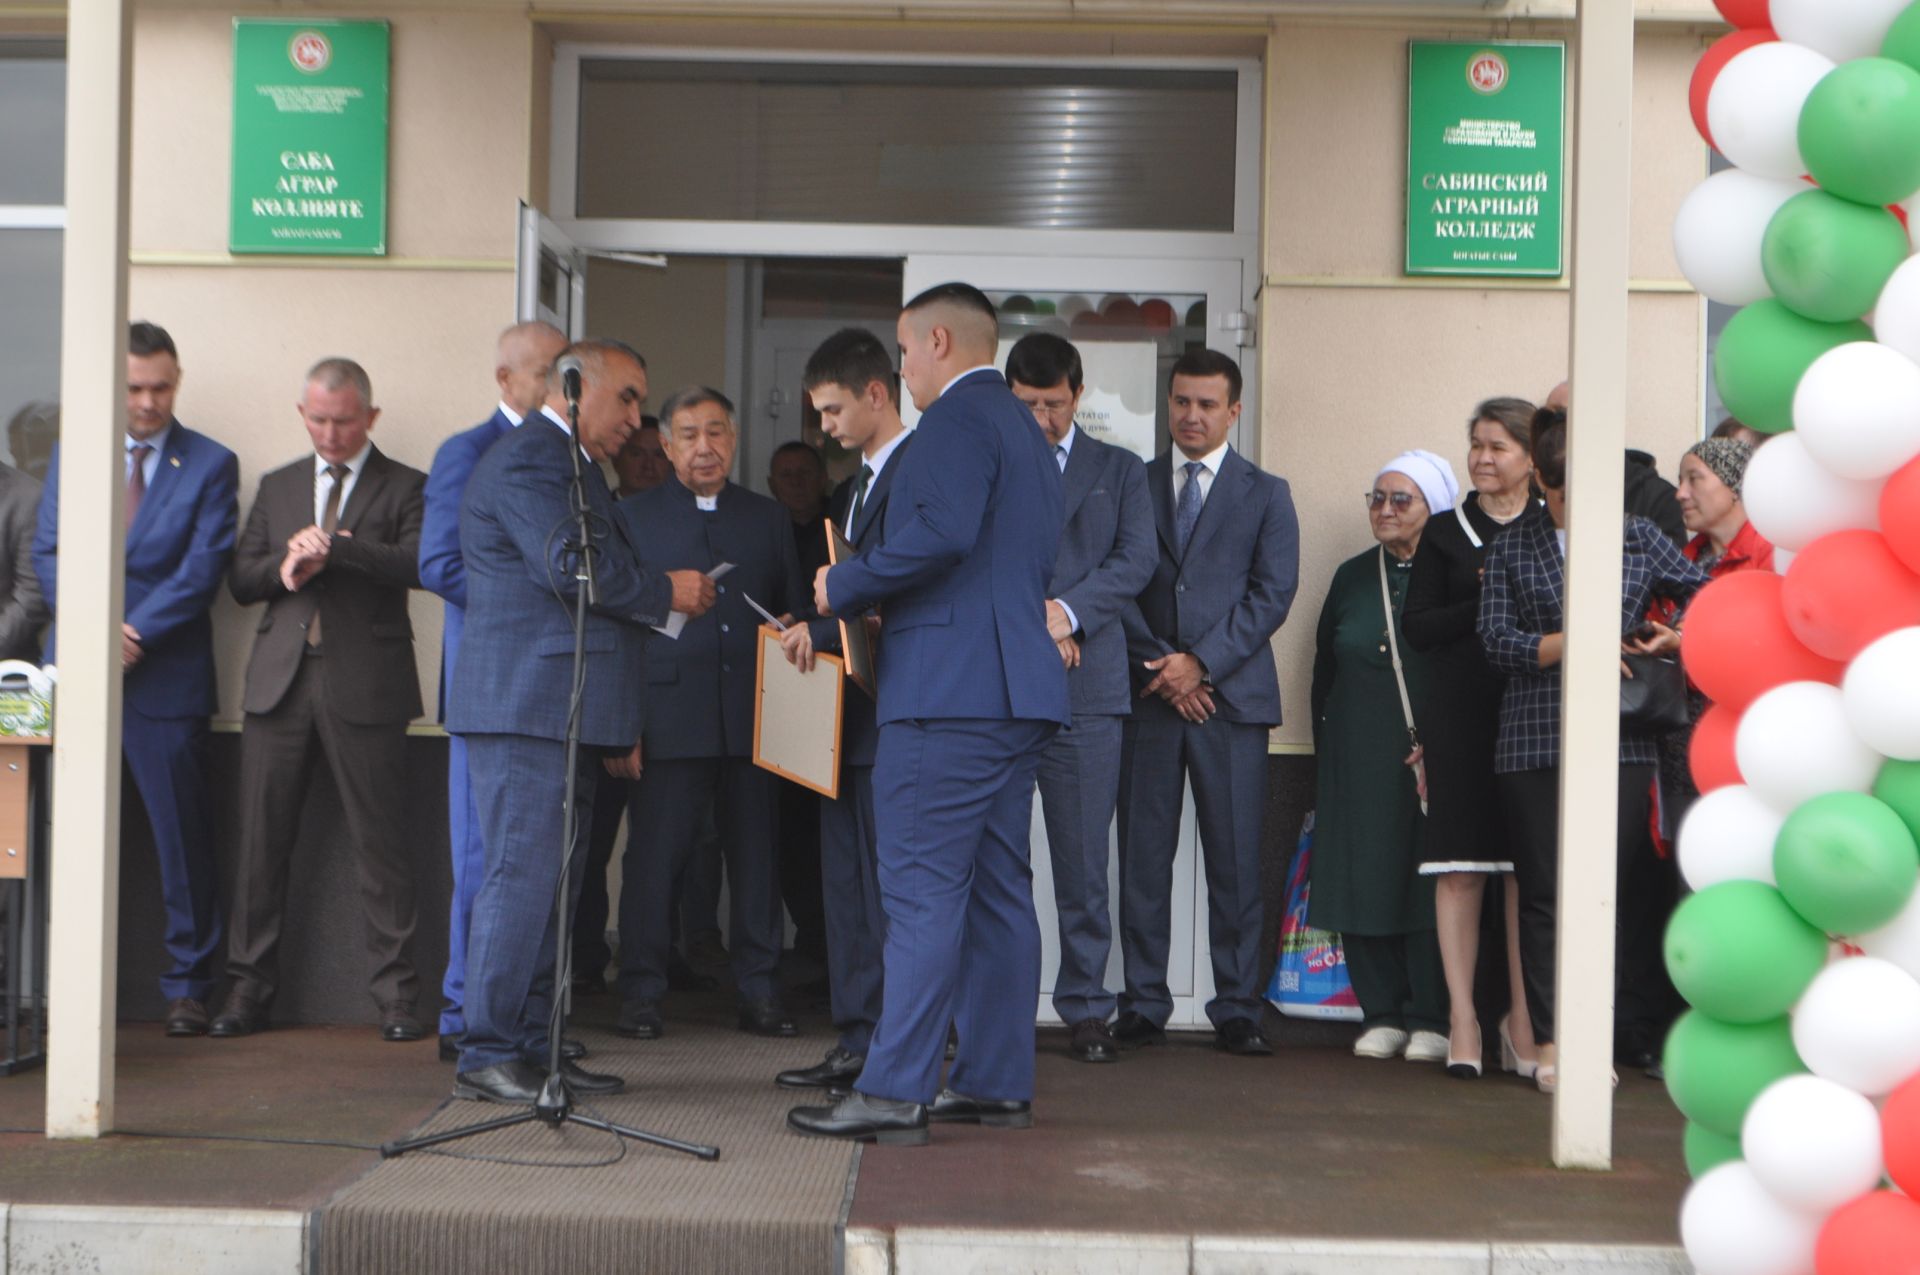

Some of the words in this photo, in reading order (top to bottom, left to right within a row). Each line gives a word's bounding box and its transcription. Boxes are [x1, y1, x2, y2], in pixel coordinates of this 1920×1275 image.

[280, 151, 335, 170] САБА
[275, 175, 338, 194] АГРАР
[1422, 171, 1548, 192] САБИНСКИЙ
[1430, 195, 1539, 216] АГРАРНЫЙ
[1435, 220, 1535, 241] КОЛЛЕДЖ
[1453, 250, 1490, 261] БОГАТЫЕ
[1492, 251, 1517, 261] САБЫ
